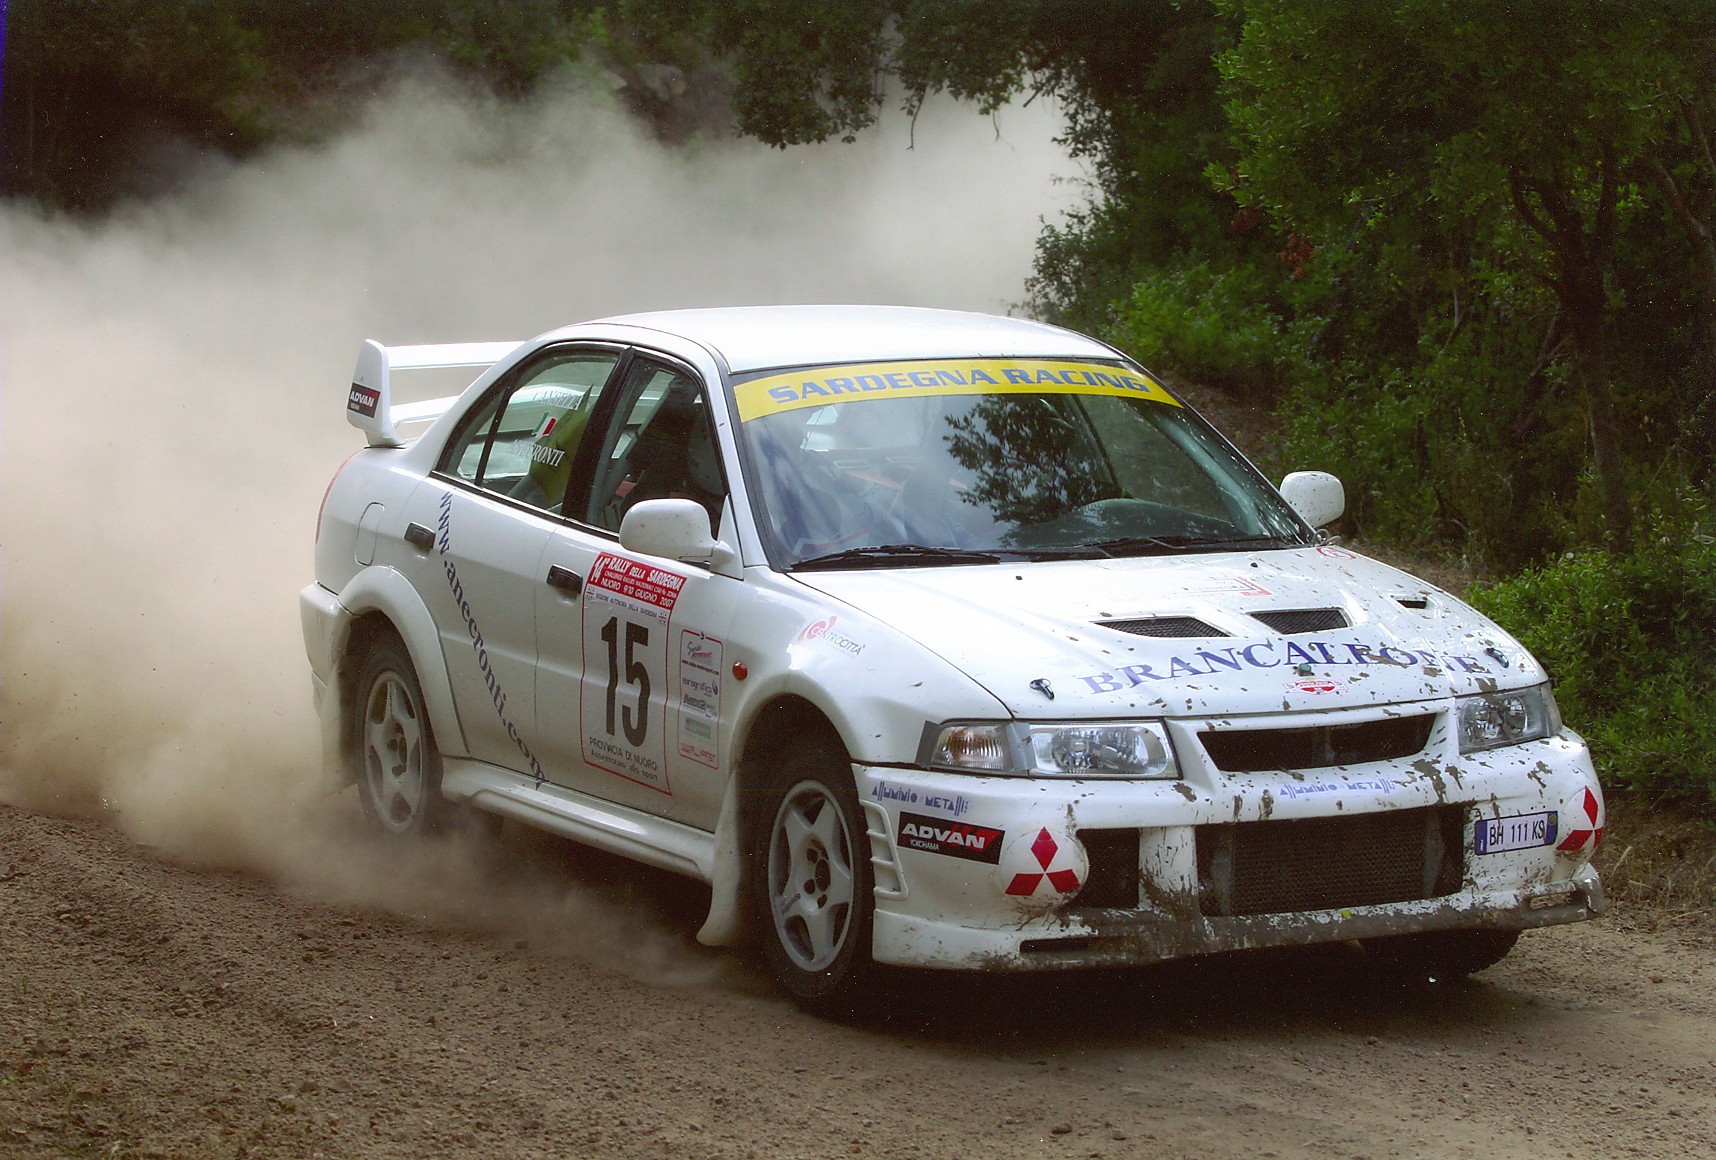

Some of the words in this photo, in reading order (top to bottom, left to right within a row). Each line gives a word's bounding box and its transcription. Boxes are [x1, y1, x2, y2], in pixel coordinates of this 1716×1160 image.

[350, 390, 375, 407] ADVAN
[768, 369, 1001, 404] SARDEGNA
[1001, 369, 1151, 393] RACING
[608, 557, 632, 574] RALLY
[628, 566, 647, 579] DELLA
[647, 569, 684, 591] SARDEGNA
[601, 577, 622, 591] NUORO
[635, 588, 658, 602] GIUGNO
[660, 596, 674, 608] 2007
[438, 490, 549, 791] www.anecronti.com
[601, 616, 650, 747] 15
[1077, 641, 1492, 695] BRANCALEONE
[589, 736, 624, 758] PROVINCIA
[634, 753, 658, 771] NUORO
[901, 822, 986, 849] ADVAN
[909, 838, 940, 851] YOKOHAMA
[1489, 824, 1504, 846] BH
[1511, 822, 1528, 843] 111
[1532, 819, 1546, 841] KS
